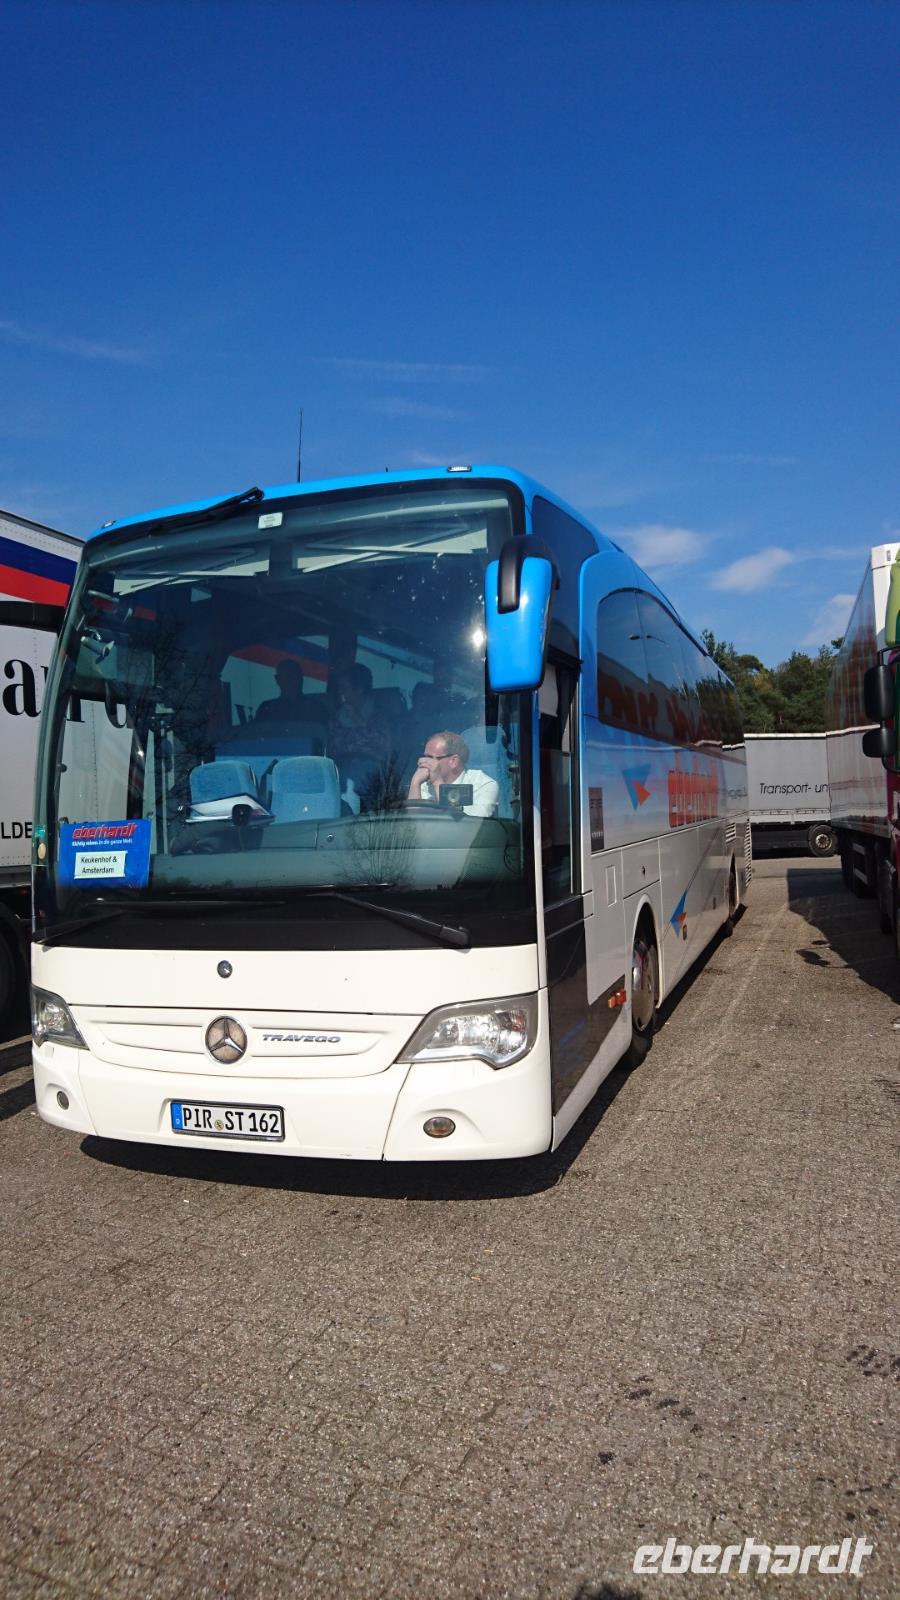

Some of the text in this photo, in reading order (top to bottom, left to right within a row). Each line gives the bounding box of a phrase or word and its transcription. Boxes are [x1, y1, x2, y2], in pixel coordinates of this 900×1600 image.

[760, 782, 811, 796] Transport-
[81, 856, 111, 864] Keukenhof
[82, 867, 114, 875] Amsterdam
[262, 1034, 342, 1044] TRAVEGO
[182, 1107, 280, 1133] PIR ST 162
